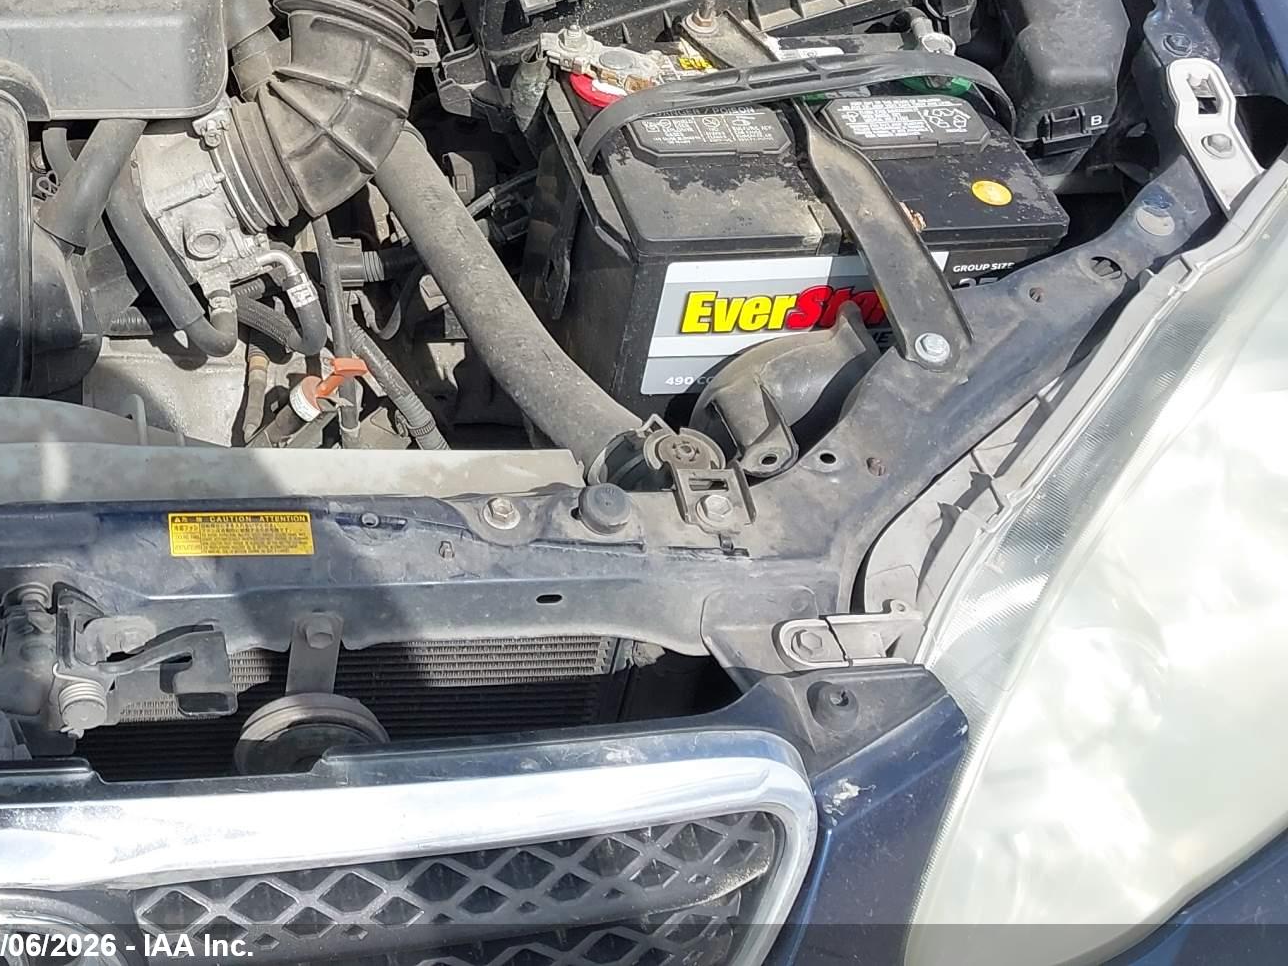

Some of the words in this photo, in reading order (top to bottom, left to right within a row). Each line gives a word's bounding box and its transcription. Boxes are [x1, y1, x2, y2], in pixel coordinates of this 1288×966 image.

[712, 104, 755, 115] POISON
[1090, 114, 1103, 126] B
[953, 263, 990, 273] GROUP
[680, 285, 888, 334] EverSta
[665, 376, 694, 385] 490
[696, 376, 714, 385] CC
[210, 515, 252, 523] CAUTION
[259, 515, 306, 523] ATTENTION
